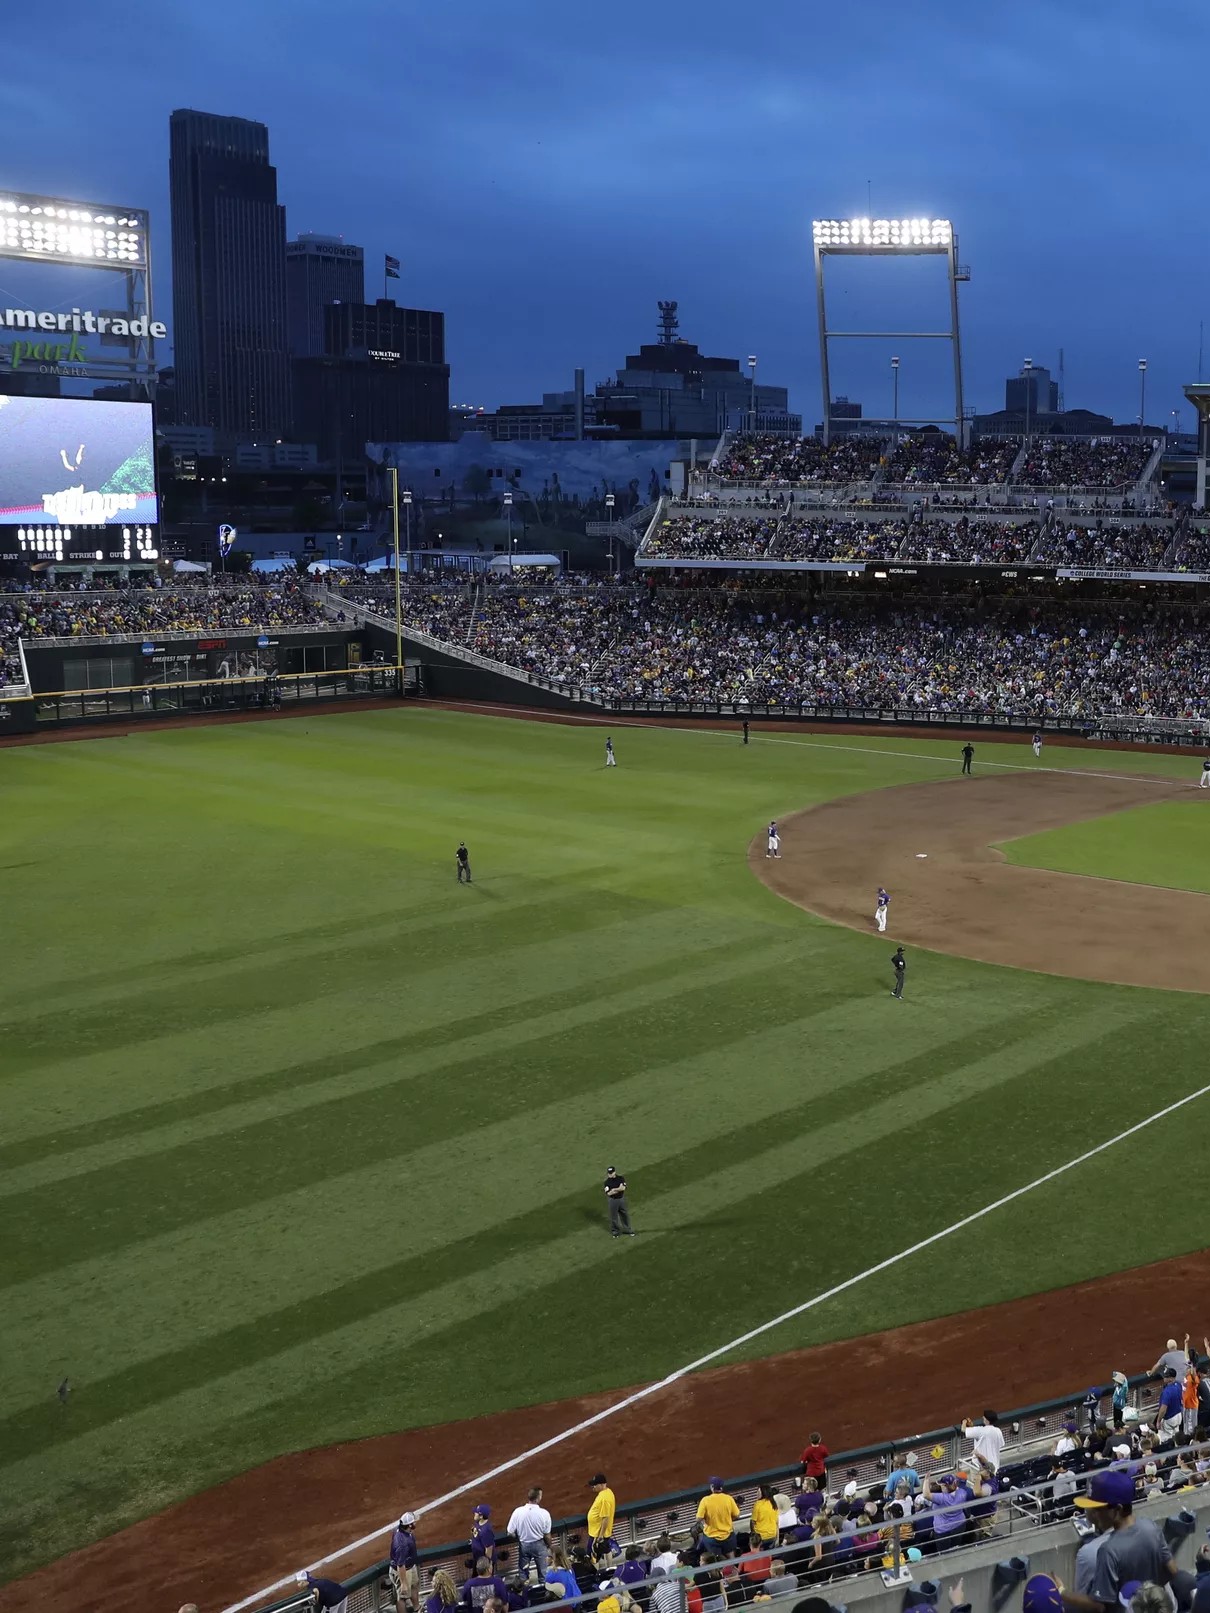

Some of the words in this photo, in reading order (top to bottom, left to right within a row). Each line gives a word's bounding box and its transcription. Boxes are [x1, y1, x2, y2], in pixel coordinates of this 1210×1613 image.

[11, 333, 88, 369] park
[39, 365, 89, 378] OMAHA
[137, 528, 143, 539] 2
[22, 541, 26, 550] 1
[31, 541, 36, 550] 1
[124, 540, 131, 550] 2
[198, 640, 227, 650] ESPN
